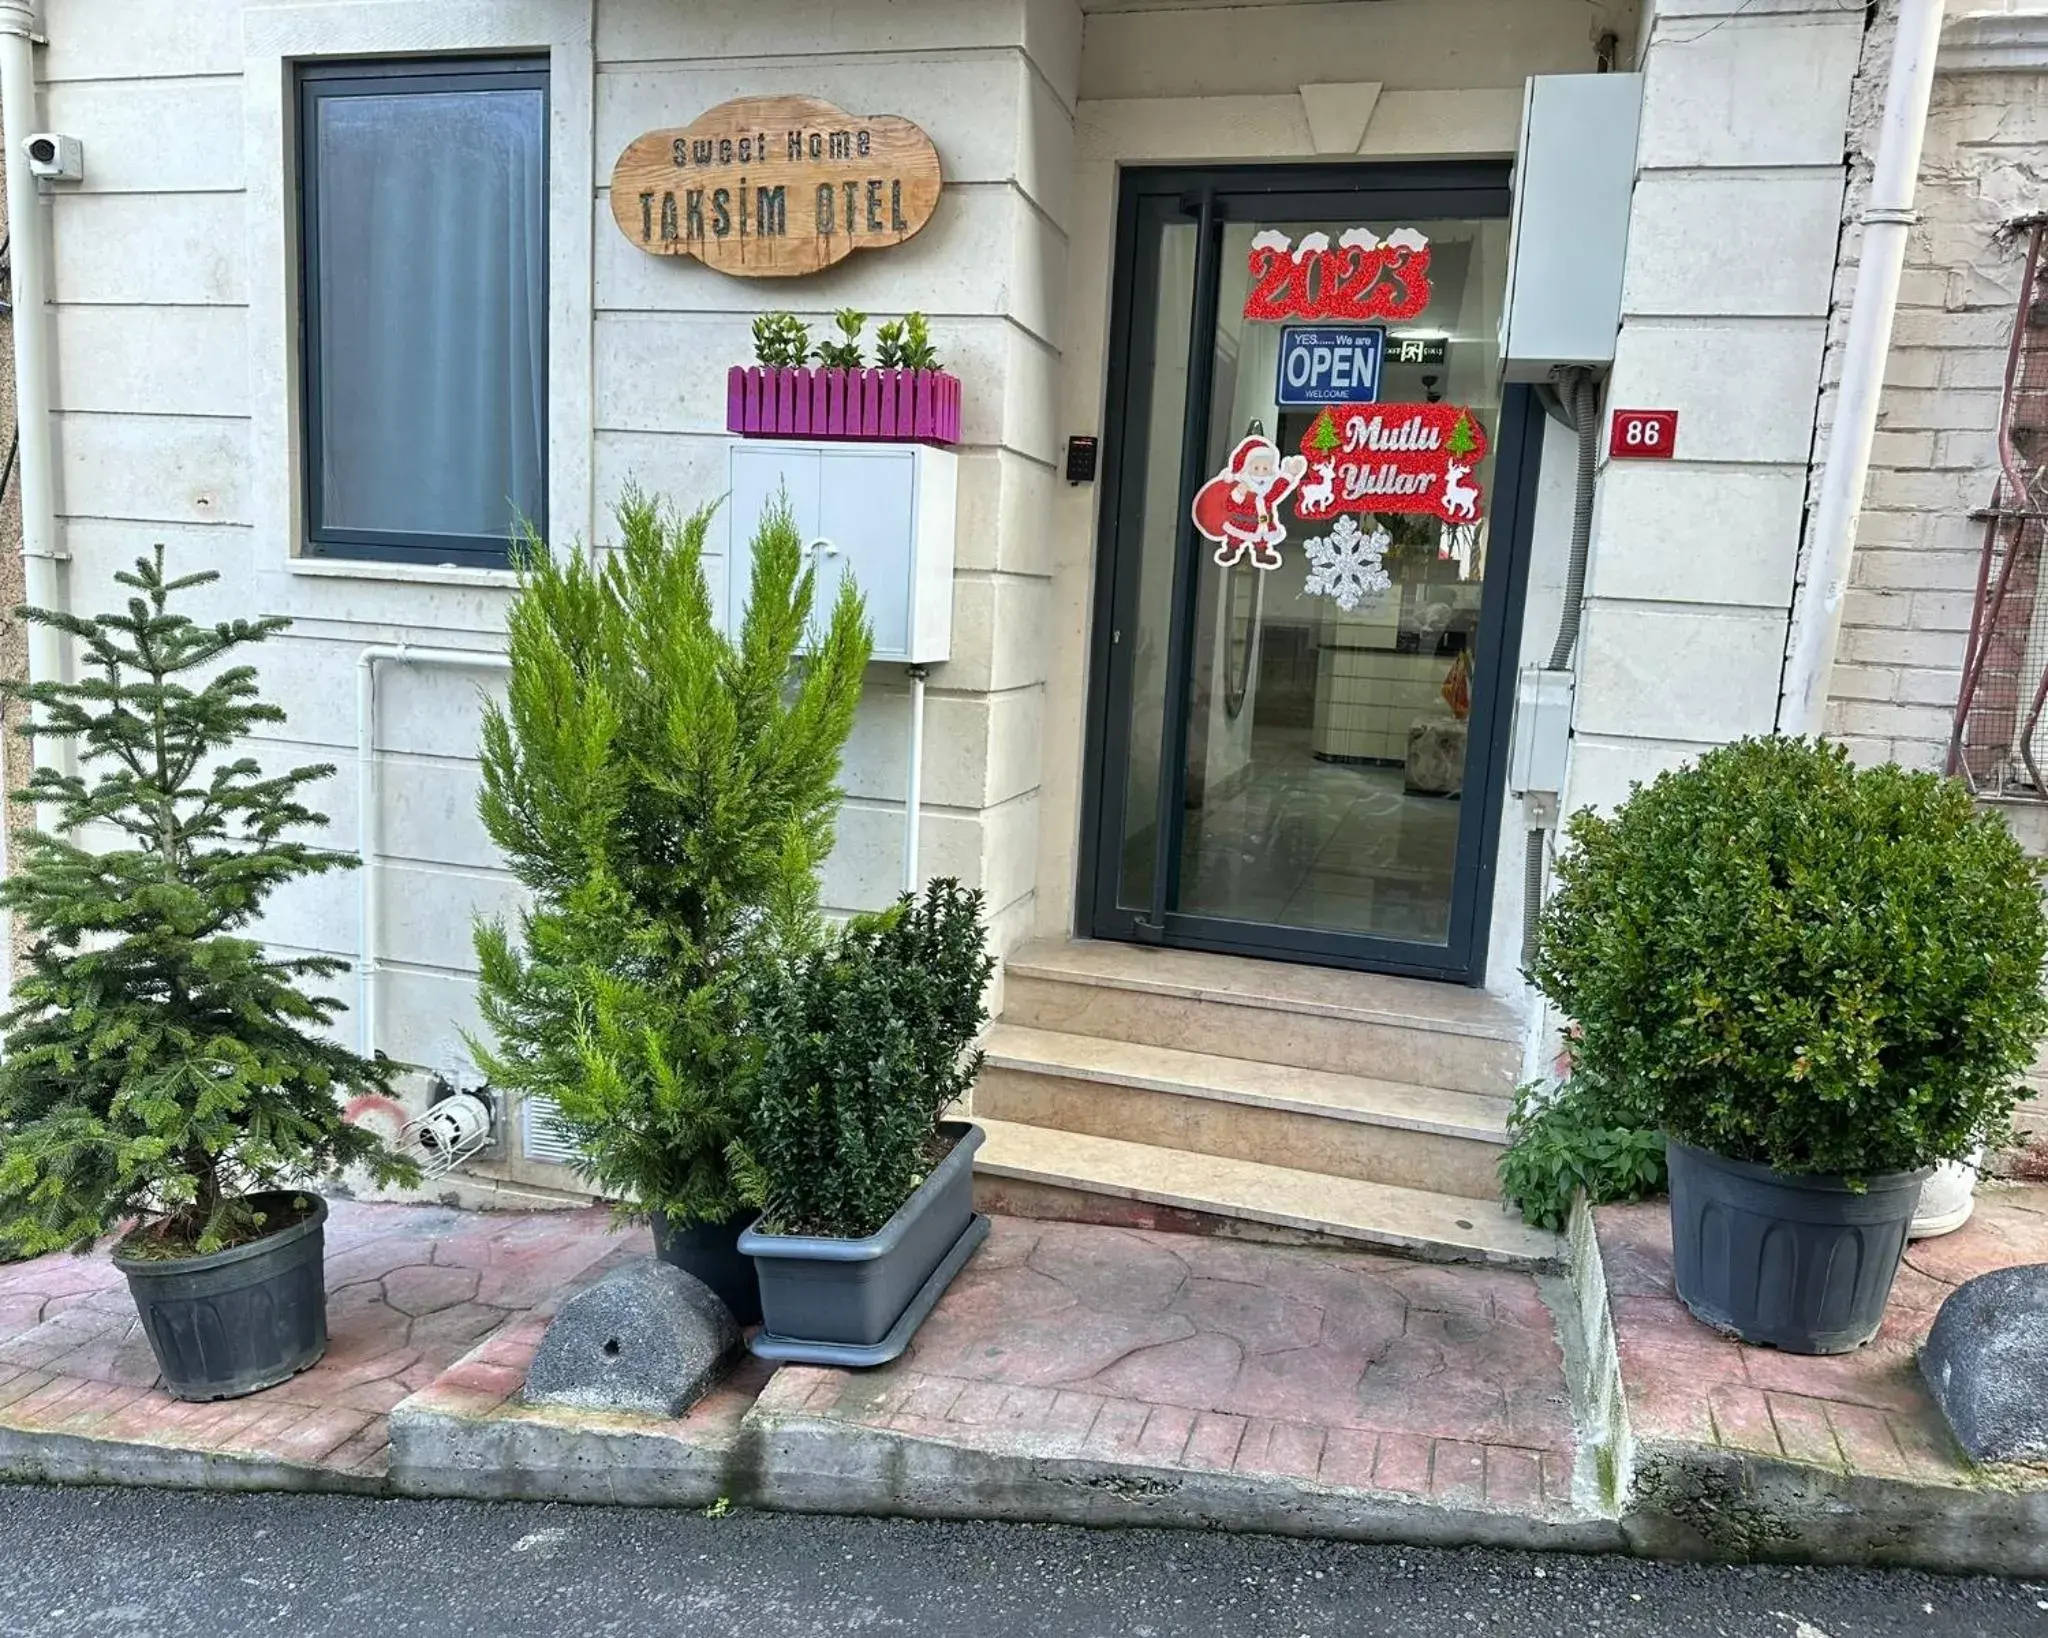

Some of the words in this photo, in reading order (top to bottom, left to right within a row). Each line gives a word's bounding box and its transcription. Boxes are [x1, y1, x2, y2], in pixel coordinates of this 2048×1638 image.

[672, 132, 765, 167] Sweet
[787, 130, 871, 162] Home
[815, 178, 907, 234] OTEL
[1243, 238, 1431, 321] 2023
[1336, 335, 1353, 345] We
[1355, 336, 1371, 345] are
[1287, 346, 1375, 388] OPEN
[1305, 390, 1349, 398] WELCOME
[1343, 415, 1442, 453] Mutlu
[1626, 420, 1660, 446] 86
